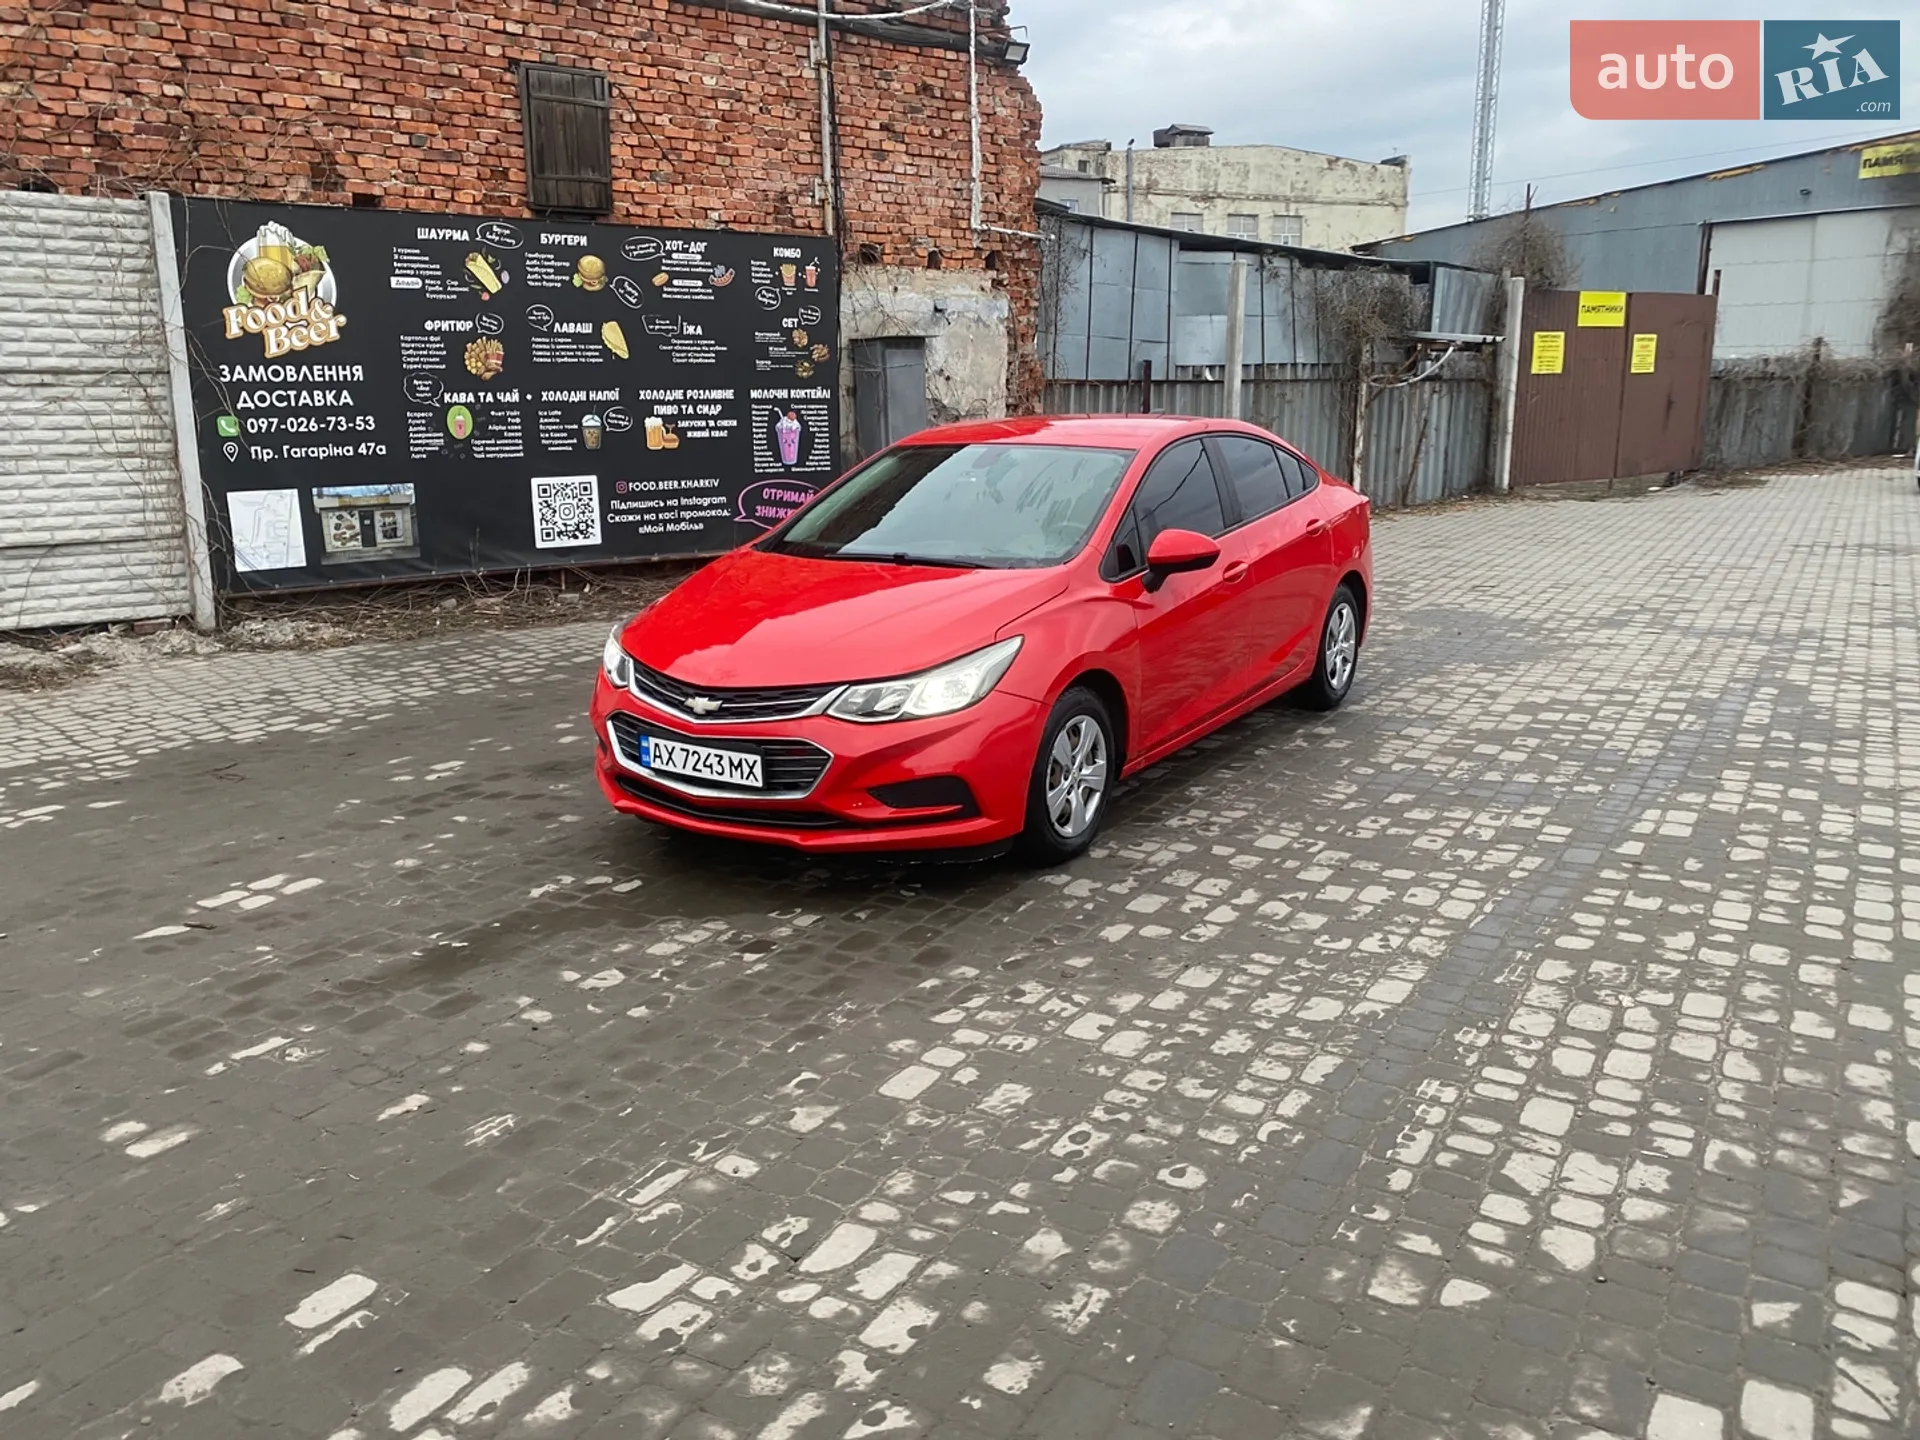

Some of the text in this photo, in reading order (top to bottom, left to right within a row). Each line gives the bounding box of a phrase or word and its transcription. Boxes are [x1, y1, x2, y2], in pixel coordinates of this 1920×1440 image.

[417, 227, 470, 241] ШАУРМА
[540, 233, 588, 247] БУРГЕРИ
[665, 240, 708, 253] ХОТ-ДОГ
[773, 247, 802, 258] КОМБО
[424, 319, 474, 332] ФРИТЮР
[553, 322, 593, 334] ЛАВАШ
[682, 322, 703, 336] ЇЖА
[782, 317, 799, 328] СЕТ
[264, 314, 347, 359] Beer
[218, 364, 364, 383] ЗАМОВЛЕННЯ
[236, 389, 354, 410] ДОСТАВКА
[443, 388, 519, 403] КАВА ТА ЧАЙ
[541, 387, 620, 403] ХОЛОДНІ НАПОЇ
[639, 389, 734, 402] ХОЛОДНЕ РОЗЛИВНЕ
[750, 386, 831, 399] МОЛОЧНІ КОКТЕЙЛІ
[653, 404, 722, 416] ПИВО ТА СИДР
[246, 415, 376, 434] 097-026-73-53
[250, 445, 278, 463] Пр.
[282, 443, 354, 460] Гагаріна
[628, 478, 719, 492] FOOD.BEER.KHARKIV
[610, 495, 727, 510] Підпишись на Instagram
[607, 513, 641, 523] Скажи
[643, 513, 656, 521] на
[658, 509, 678, 520] касі
